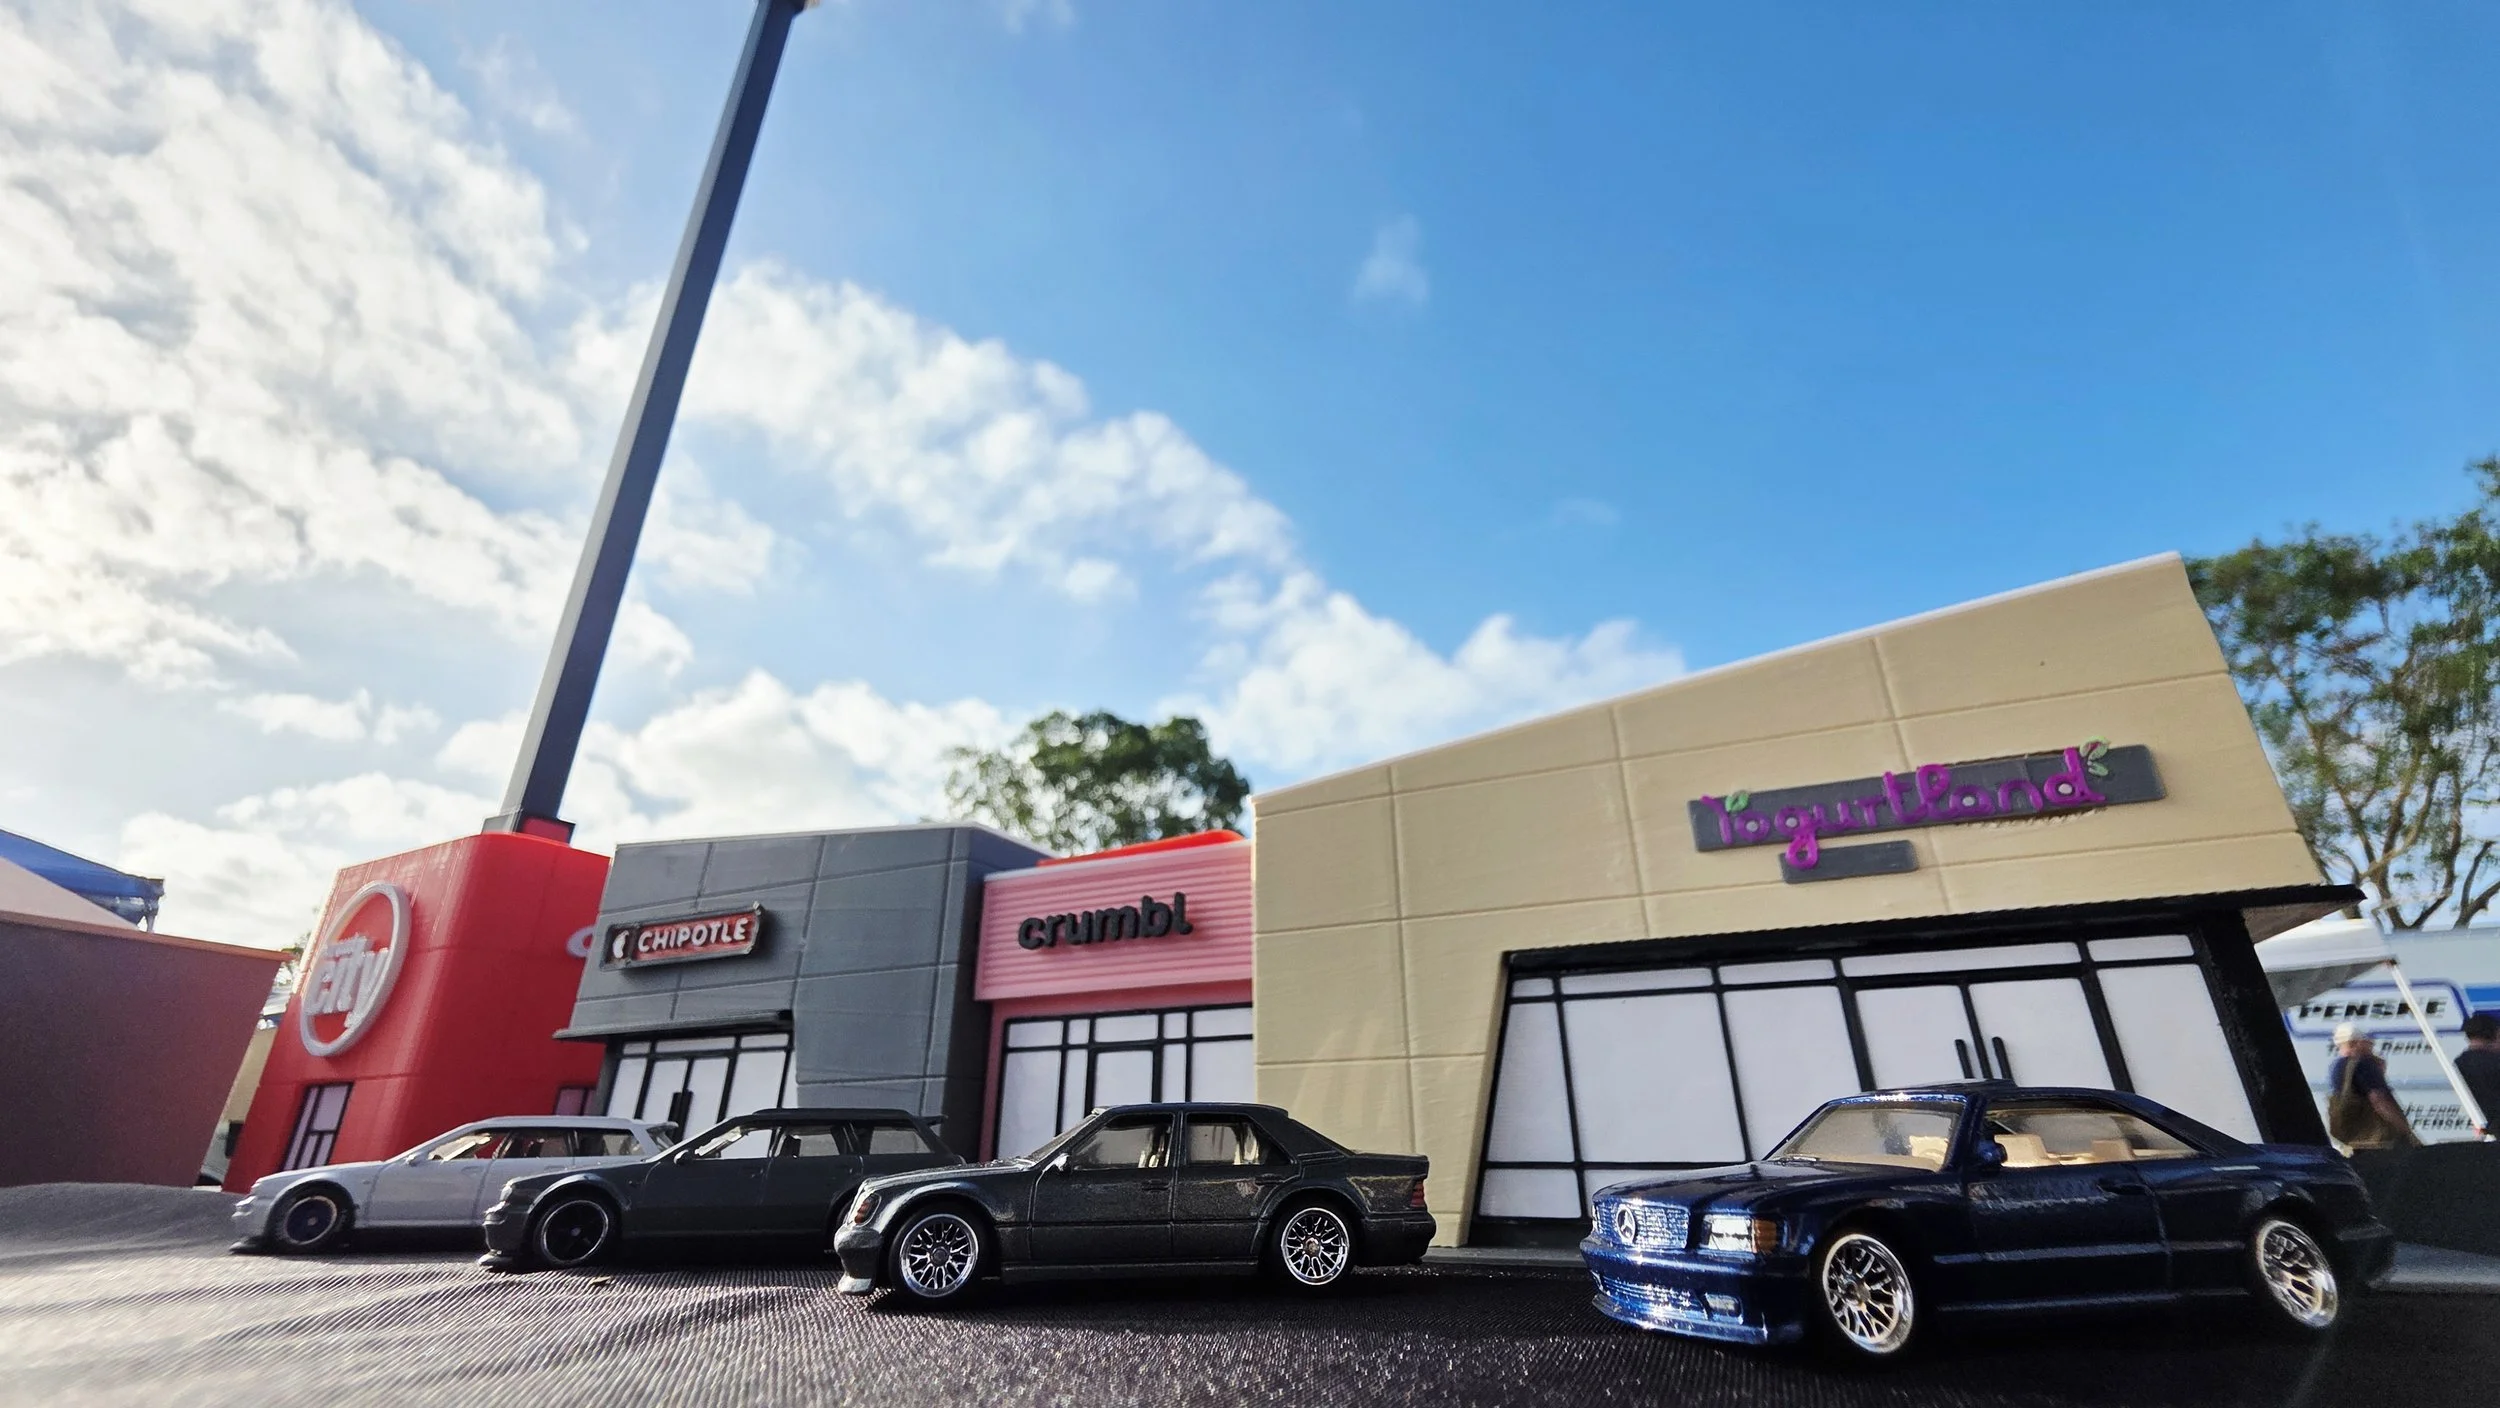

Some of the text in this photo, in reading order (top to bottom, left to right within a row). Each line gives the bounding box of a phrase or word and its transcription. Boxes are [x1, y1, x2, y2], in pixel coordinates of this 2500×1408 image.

[1700, 746, 2106, 869] Yogurtland
[637, 917, 749, 953] CHIPOTLE
[1018, 892, 1193, 950] crumbl
